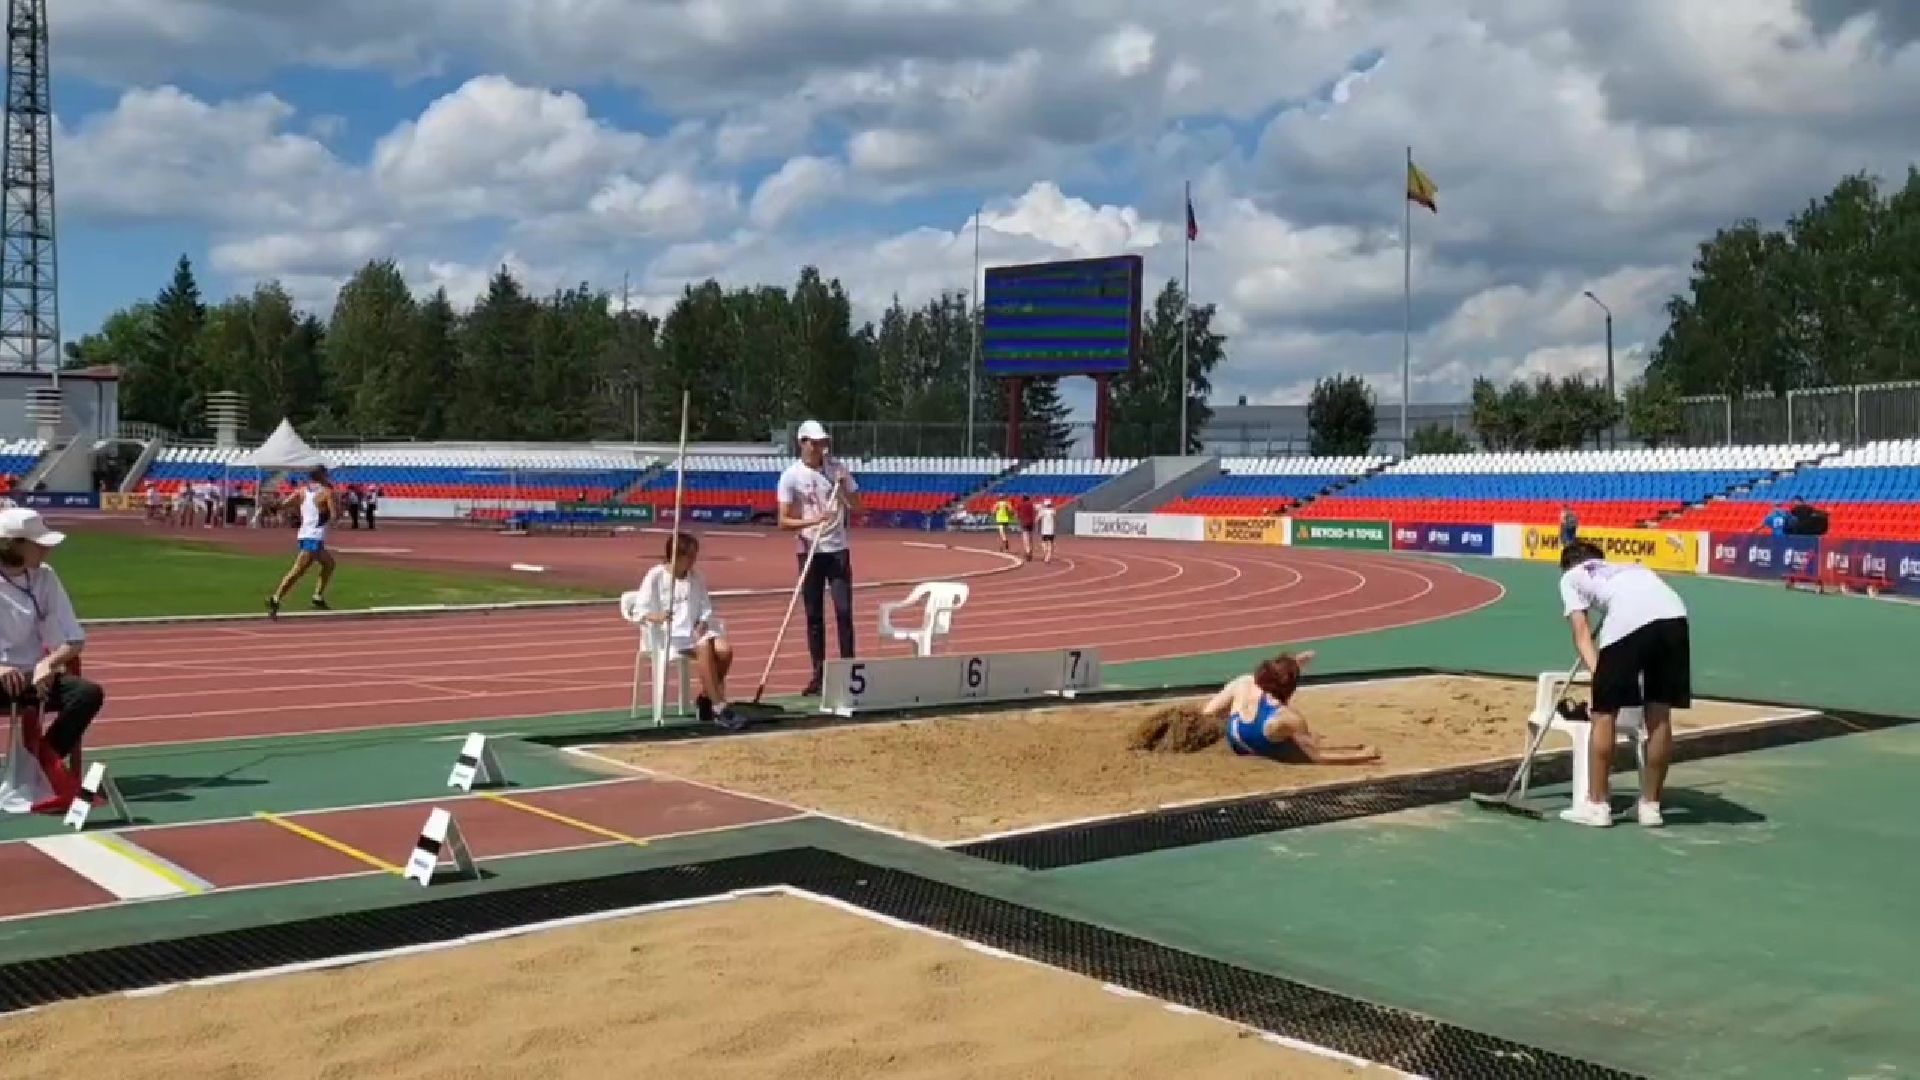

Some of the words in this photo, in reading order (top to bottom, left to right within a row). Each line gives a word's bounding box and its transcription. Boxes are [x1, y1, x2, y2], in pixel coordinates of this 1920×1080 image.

[1607, 537, 1657, 556] РОССИИ
[850, 663, 866, 694] 5
[968, 657, 982, 688] 6
[1069, 651, 1081, 679] 7
